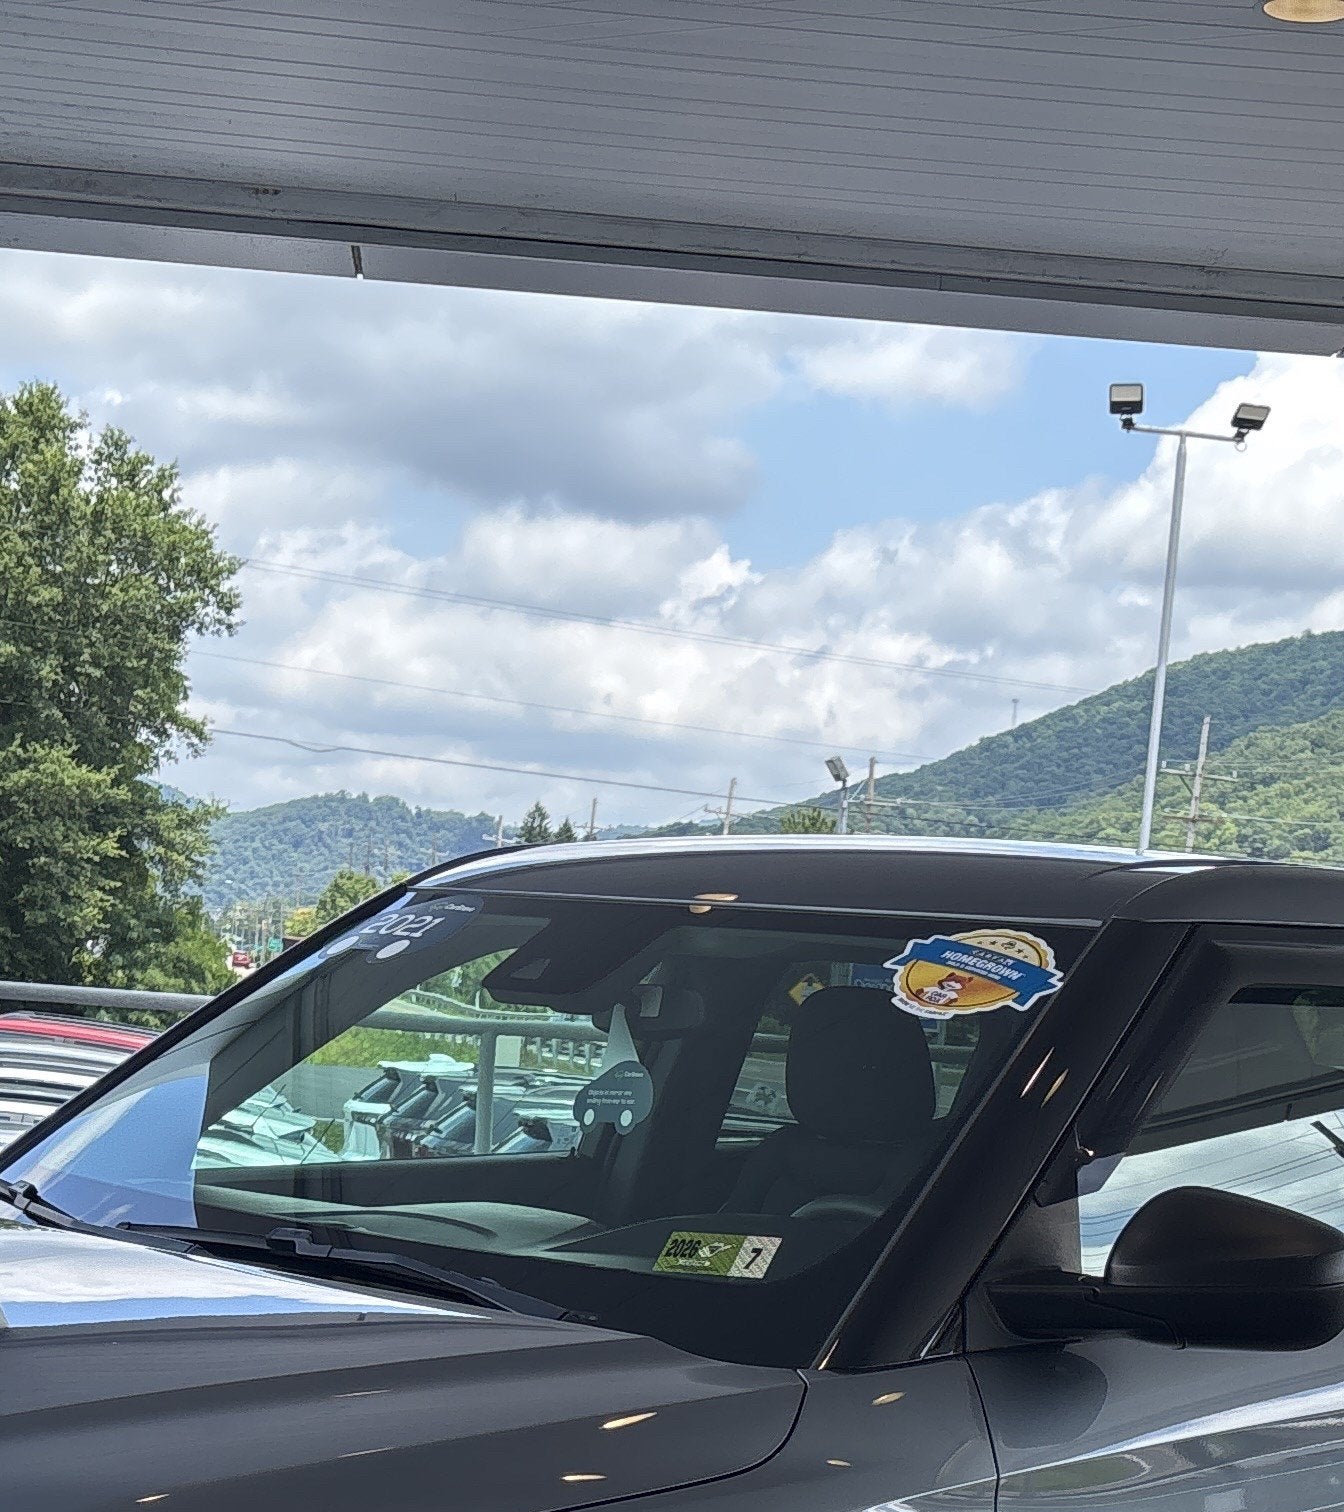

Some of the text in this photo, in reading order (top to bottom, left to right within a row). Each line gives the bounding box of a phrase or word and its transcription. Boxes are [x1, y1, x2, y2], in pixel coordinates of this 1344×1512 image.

[359, 913, 445, 938] 2021
[665, 1238, 702, 1258] 2026
[743, 1247, 764, 1270] 7
